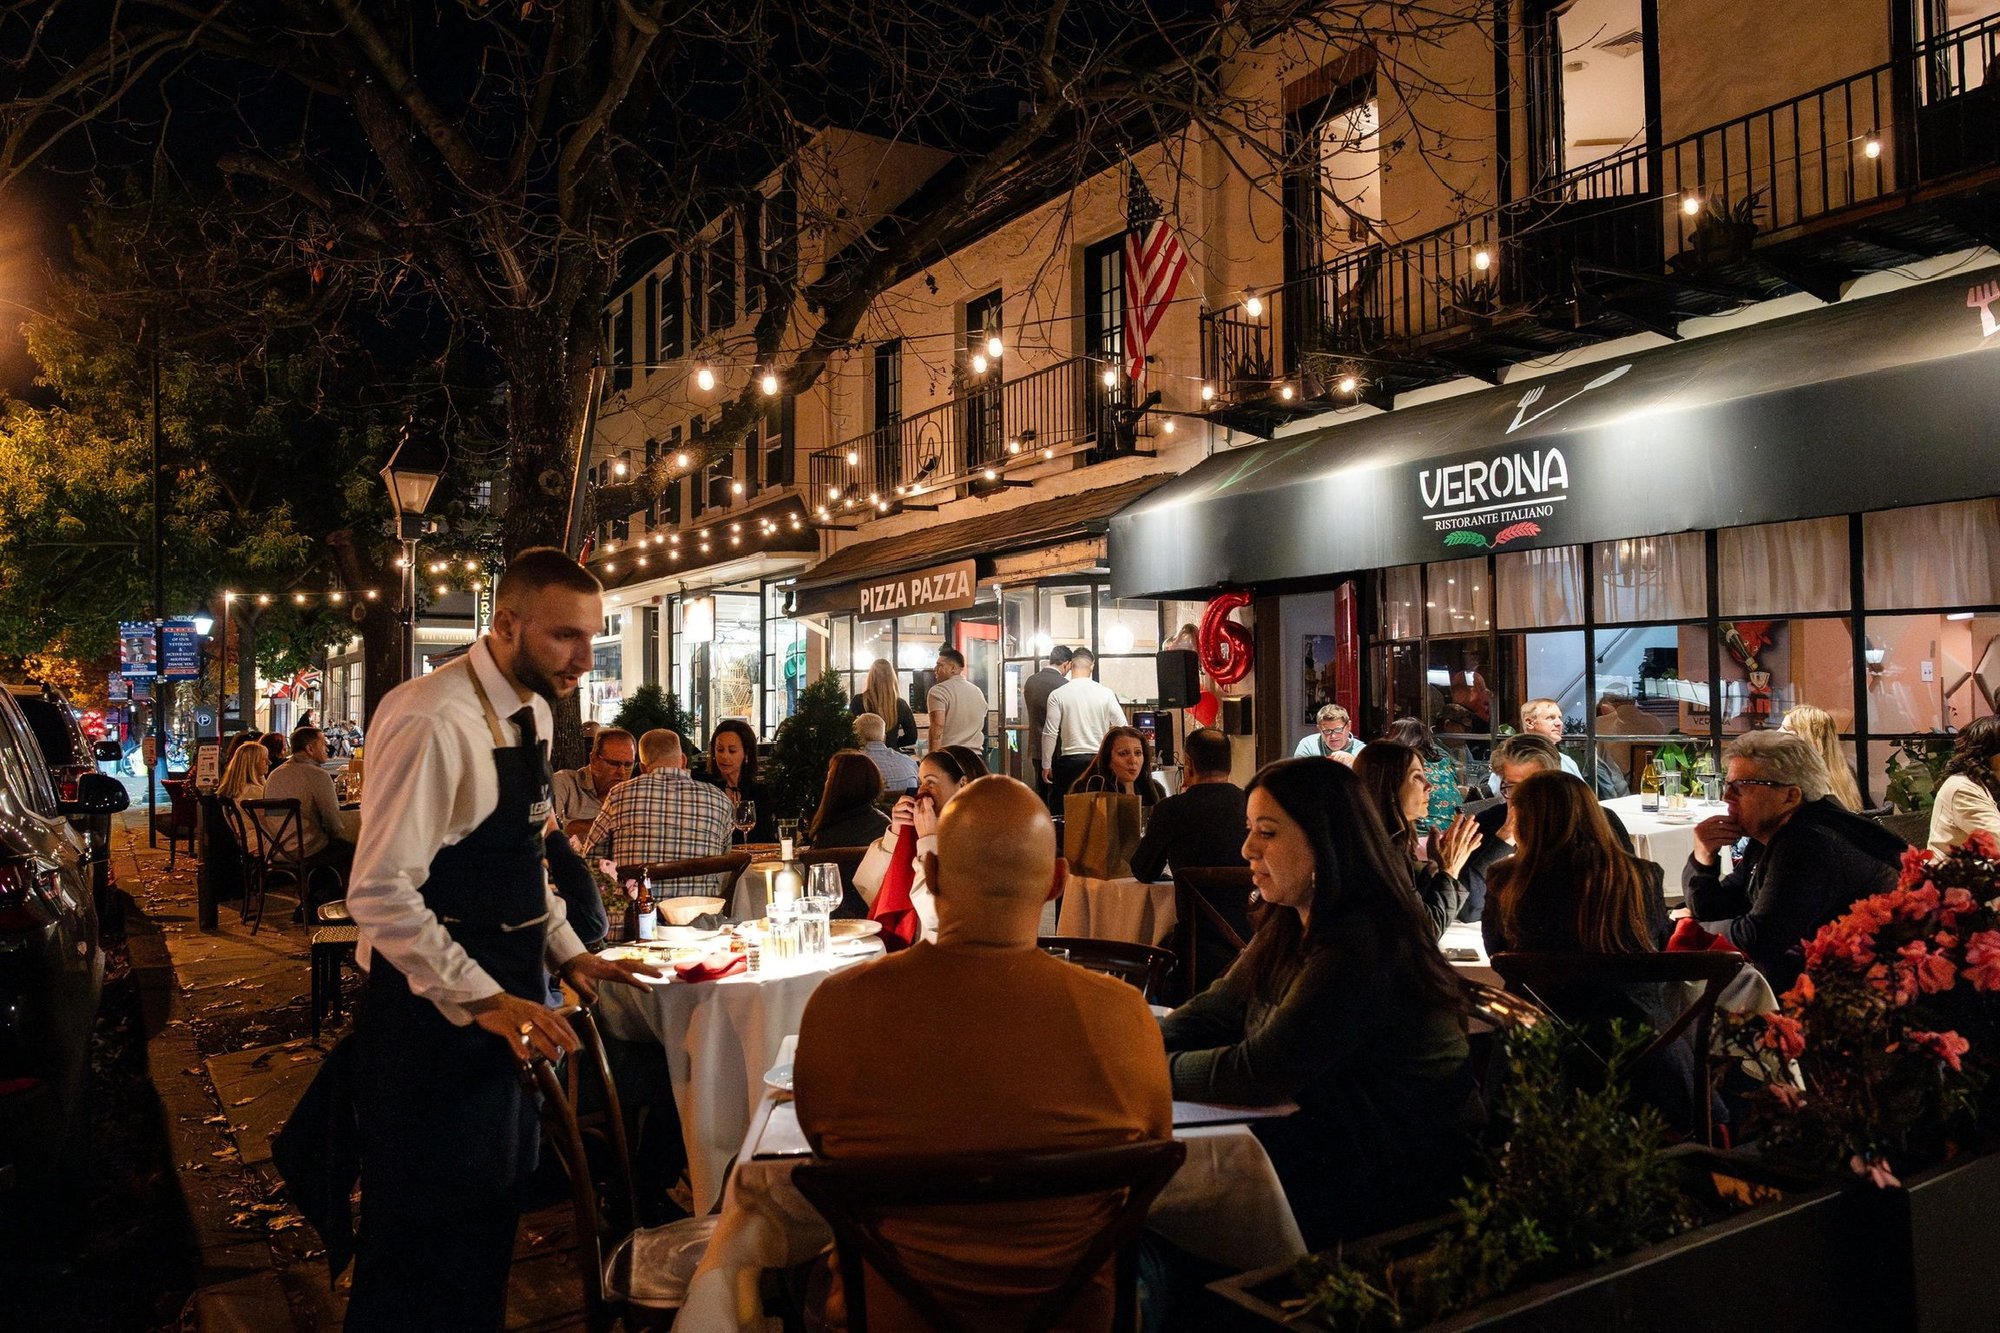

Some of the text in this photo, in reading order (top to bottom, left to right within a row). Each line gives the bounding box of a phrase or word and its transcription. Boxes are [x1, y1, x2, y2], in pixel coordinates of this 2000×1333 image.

[1419, 447, 1569, 509] VERONA
[1435, 504, 1553, 531] RISTORANTE ITALIANO
[860, 570, 970, 614] PIZZA PAZZA
